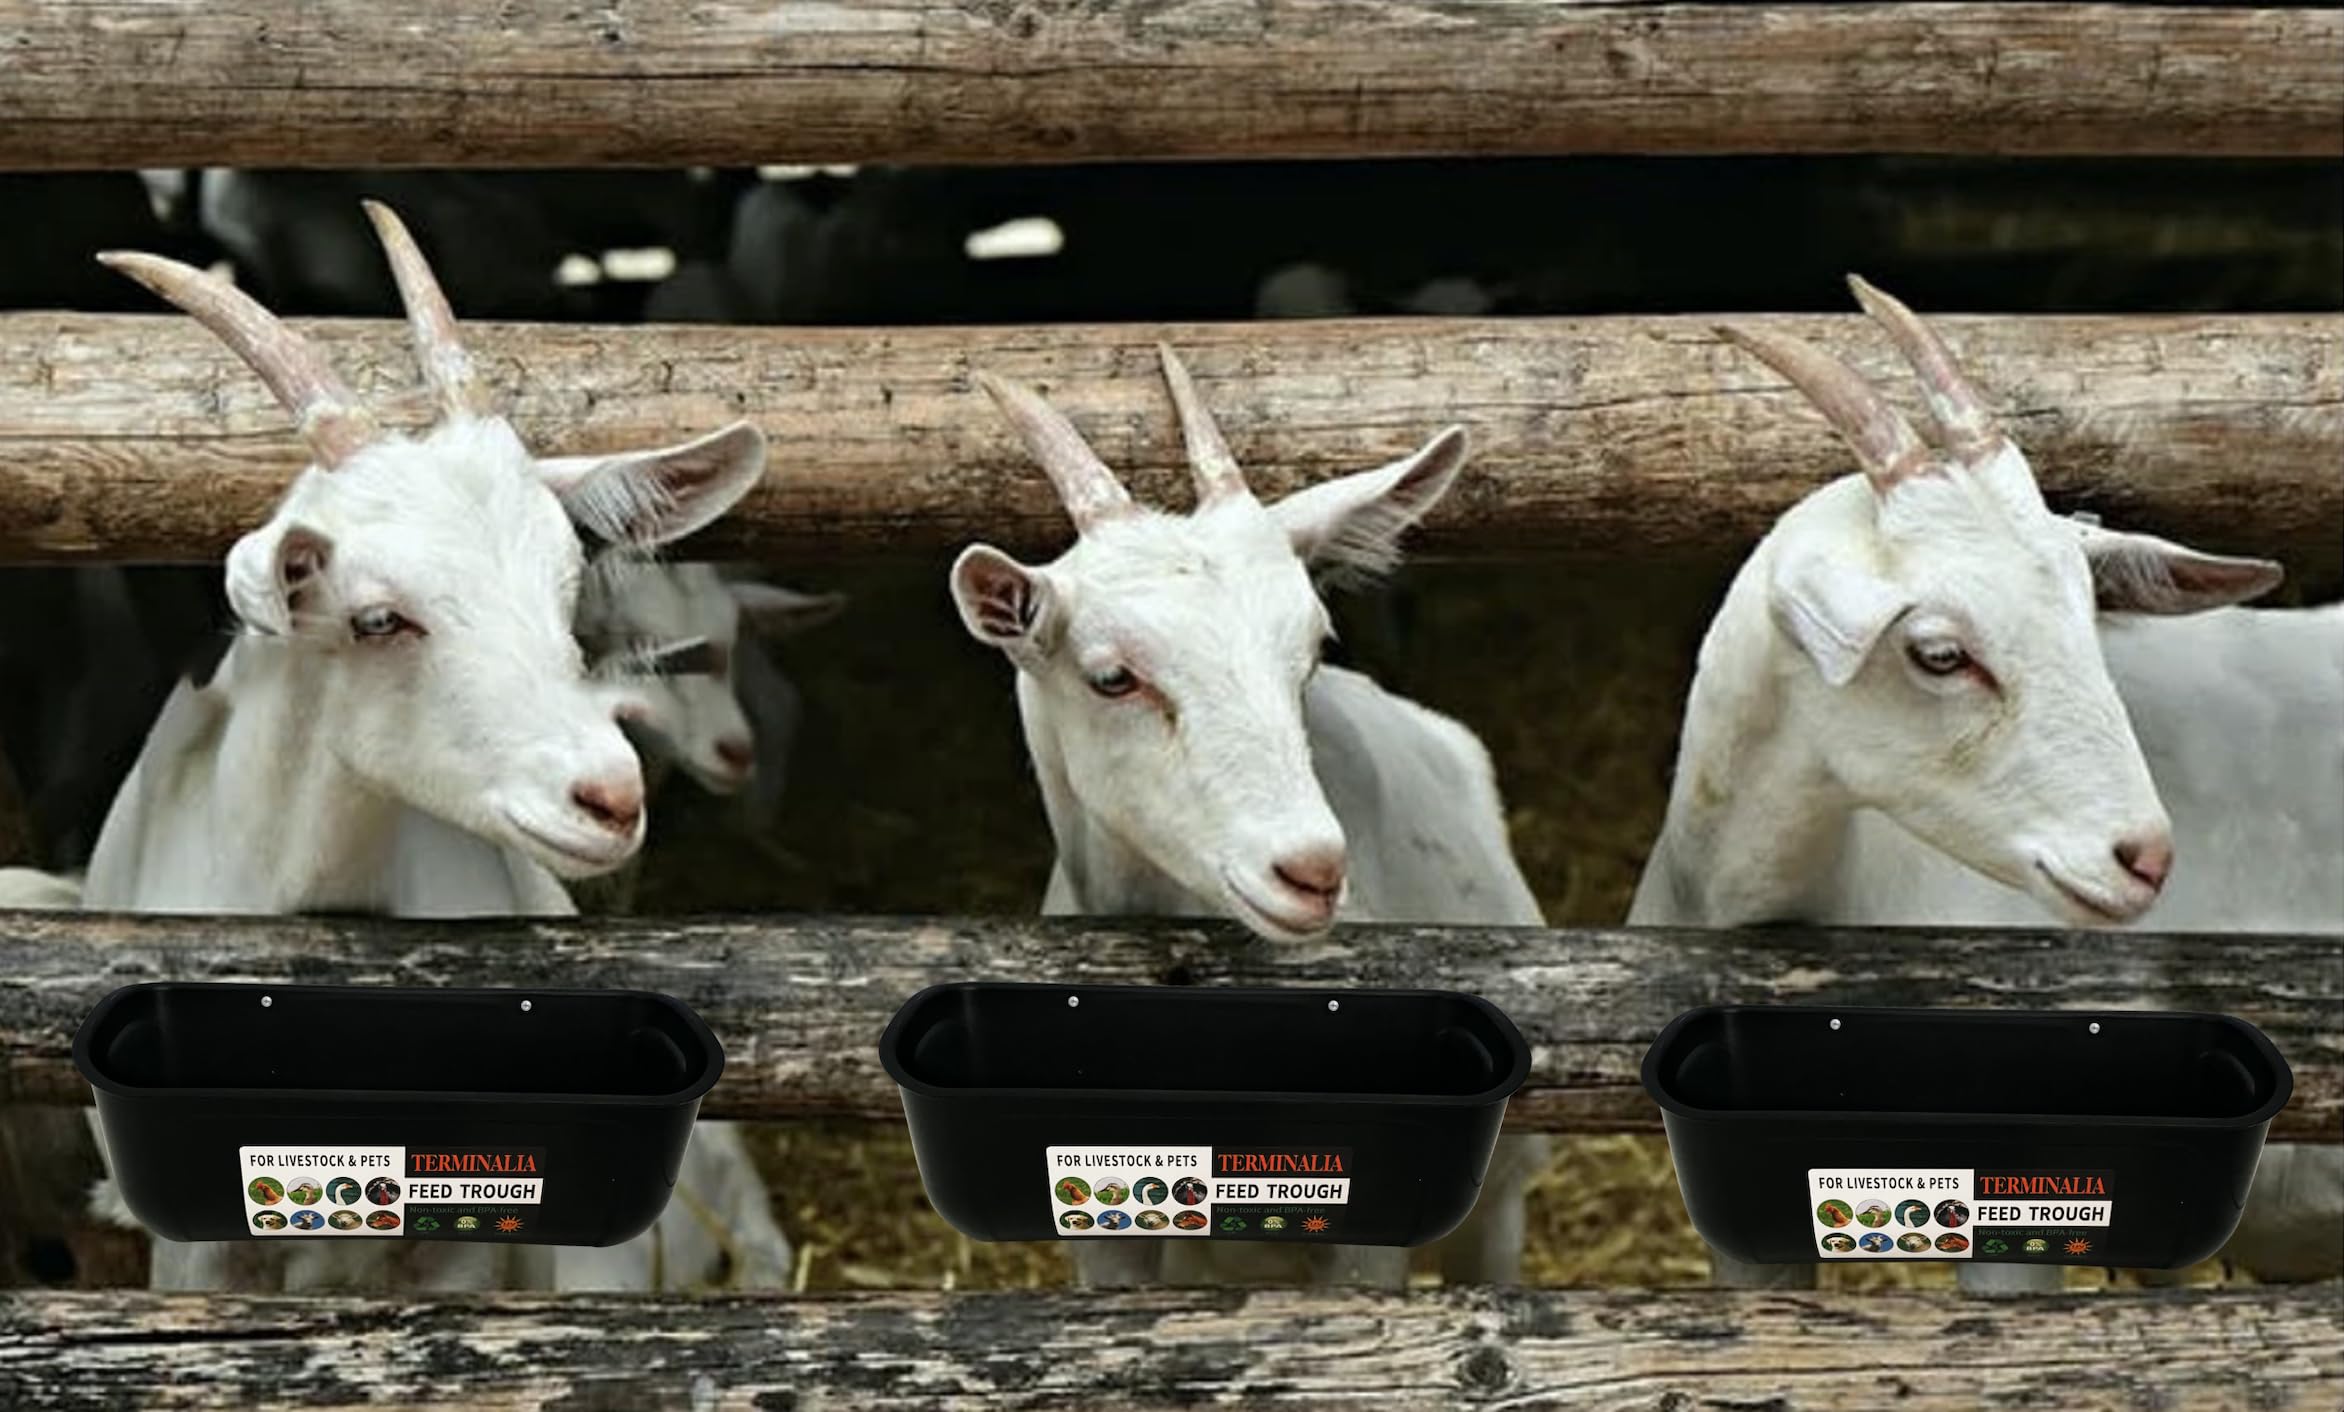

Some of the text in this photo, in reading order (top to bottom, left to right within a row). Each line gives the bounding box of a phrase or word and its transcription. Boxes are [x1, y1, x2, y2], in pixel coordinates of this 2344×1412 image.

[250, 1154, 391, 1167] FOR LIVESTOCK & PETS
[410, 1153, 537, 1173] TERMINALIA
[1057, 1154, 1198, 1167] FOR LIVESTOCK & PETS
[1217, 1153, 1344, 1173] TERMINALIA
[1819, 1176, 1960, 1189] FOR LIVESTOCK & PETS
[1979, 1175, 2106, 1195] TERMINALIA
[409, 1184, 536, 1199] FEED TROUGH
[1216, 1184, 1343, 1199] FEED TROUGH
[1978, 1206, 2105, 1221] FEED TROUGH
